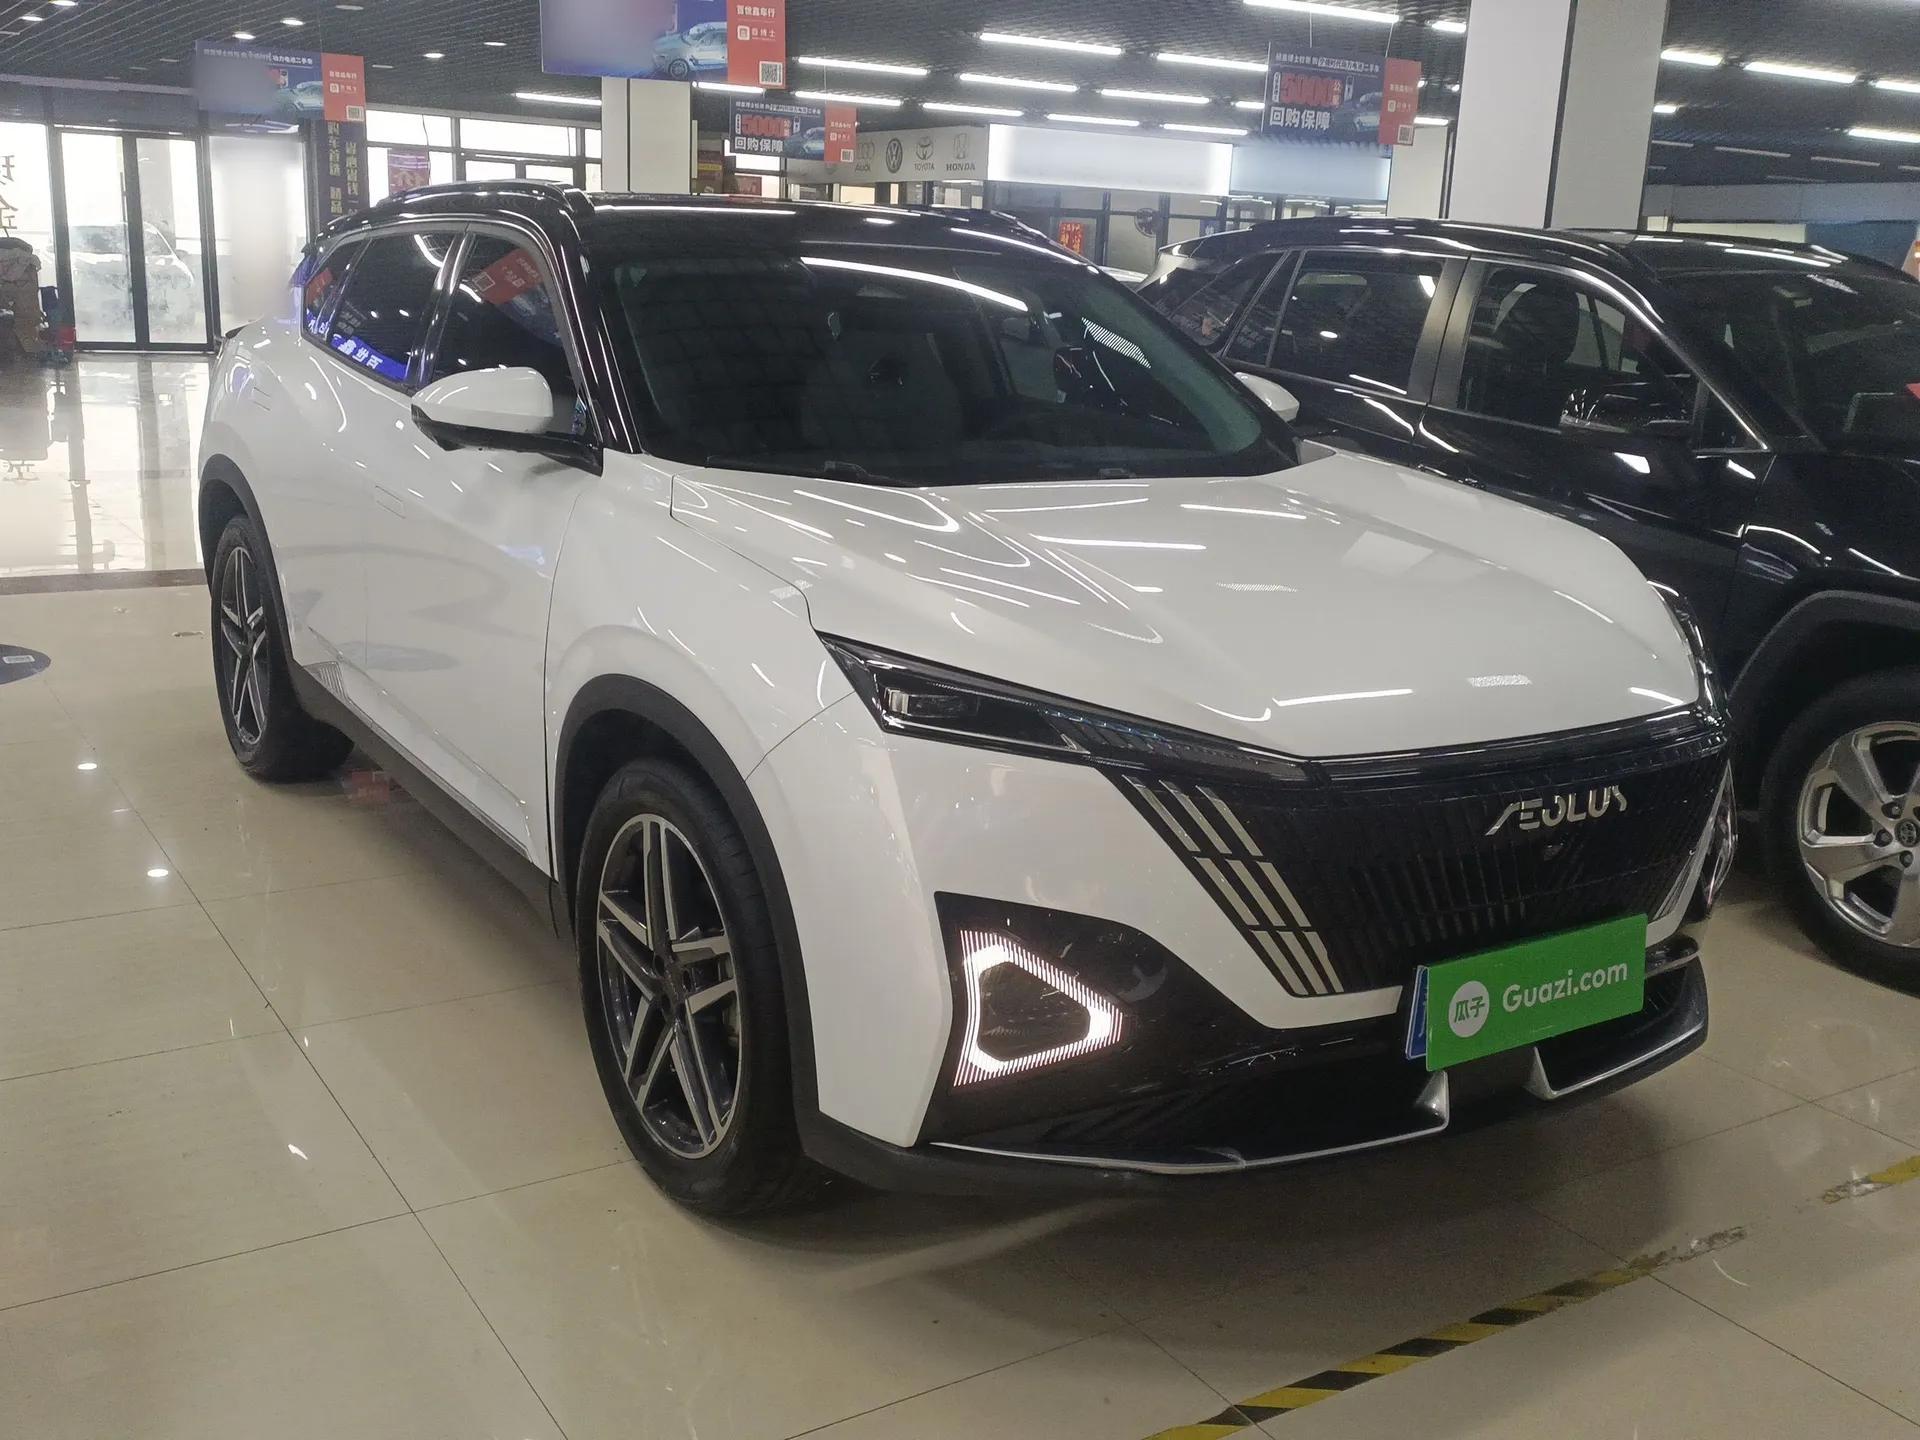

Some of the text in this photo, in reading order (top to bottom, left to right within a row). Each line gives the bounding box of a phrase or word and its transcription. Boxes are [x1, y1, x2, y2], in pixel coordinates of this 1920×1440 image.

[1269, 106, 1331, 131] 回购保障
[735, 137, 784, 154] 回购保障
[914, 162, 935, 171] TOYOTA
[946, 163, 976, 172] HONDA
[1485, 785, 1628, 836] AEOLUS
[1502, 962, 1629, 1013] Guazi.com
[1453, 996, 1486, 1023] 瓜子
